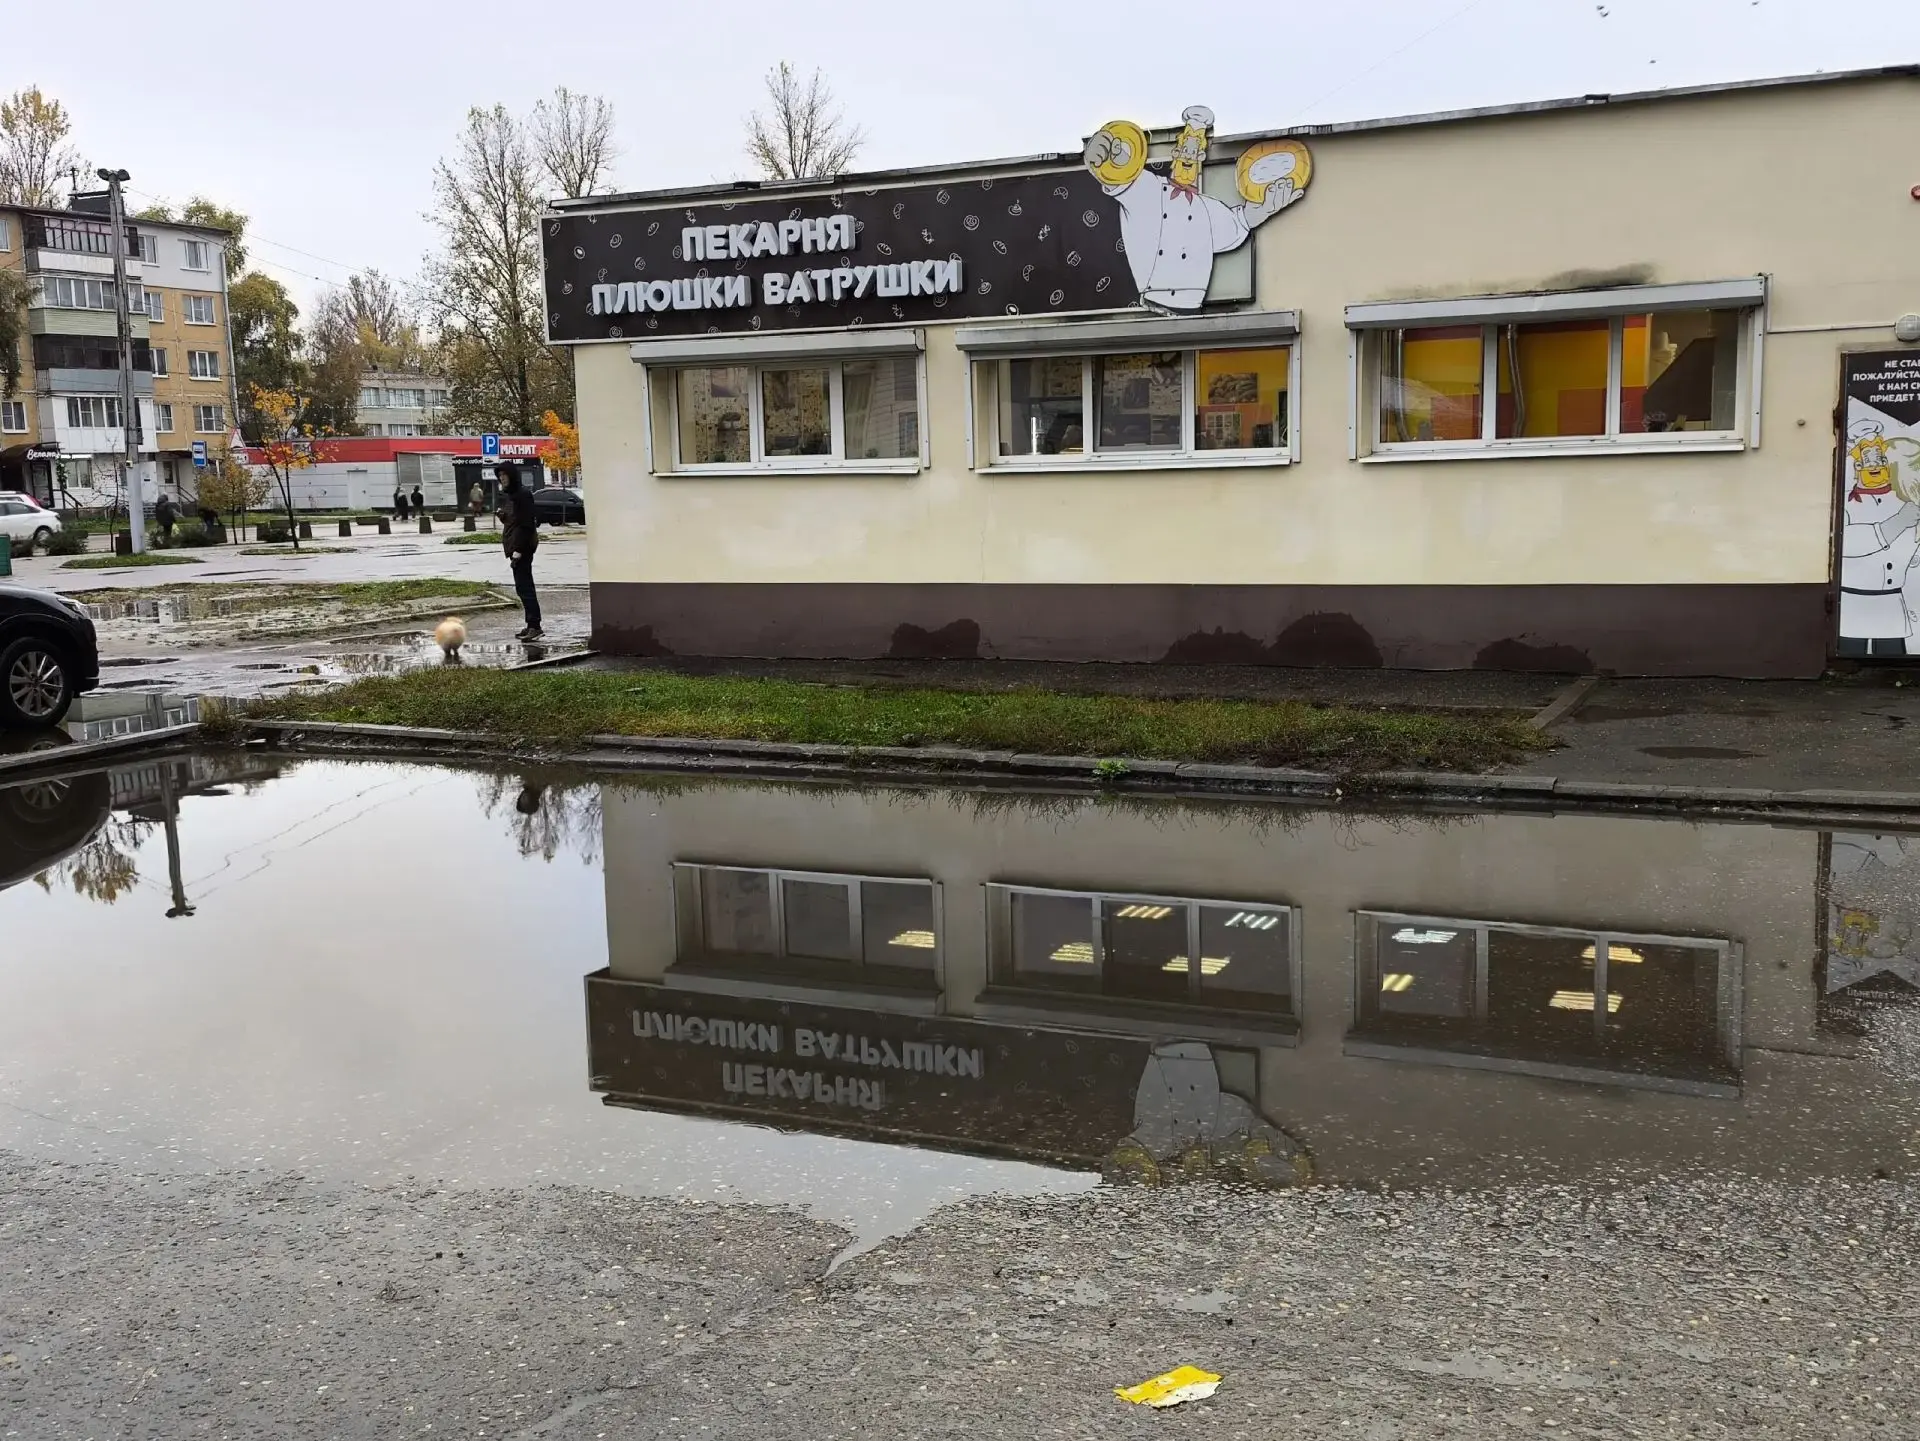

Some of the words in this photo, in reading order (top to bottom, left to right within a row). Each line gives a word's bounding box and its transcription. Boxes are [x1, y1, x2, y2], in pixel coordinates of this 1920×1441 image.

[681, 215, 856, 262] ПЕКАРНЯ
[591, 275, 751, 315] ПЛЮШКИ
[763, 259, 965, 305] ВАТРУШКИ
[1884, 360, 1898, 368] НЕ
[1852, 369, 1920, 381] ПОЖАЛУЙСТА
[1878, 383, 1885, 391] К
[1886, 382, 1909, 391] НАМ
[1869, 394, 1915, 402] ПРИЕДЕТ
[500, 444, 537, 455] МАГНИТ
